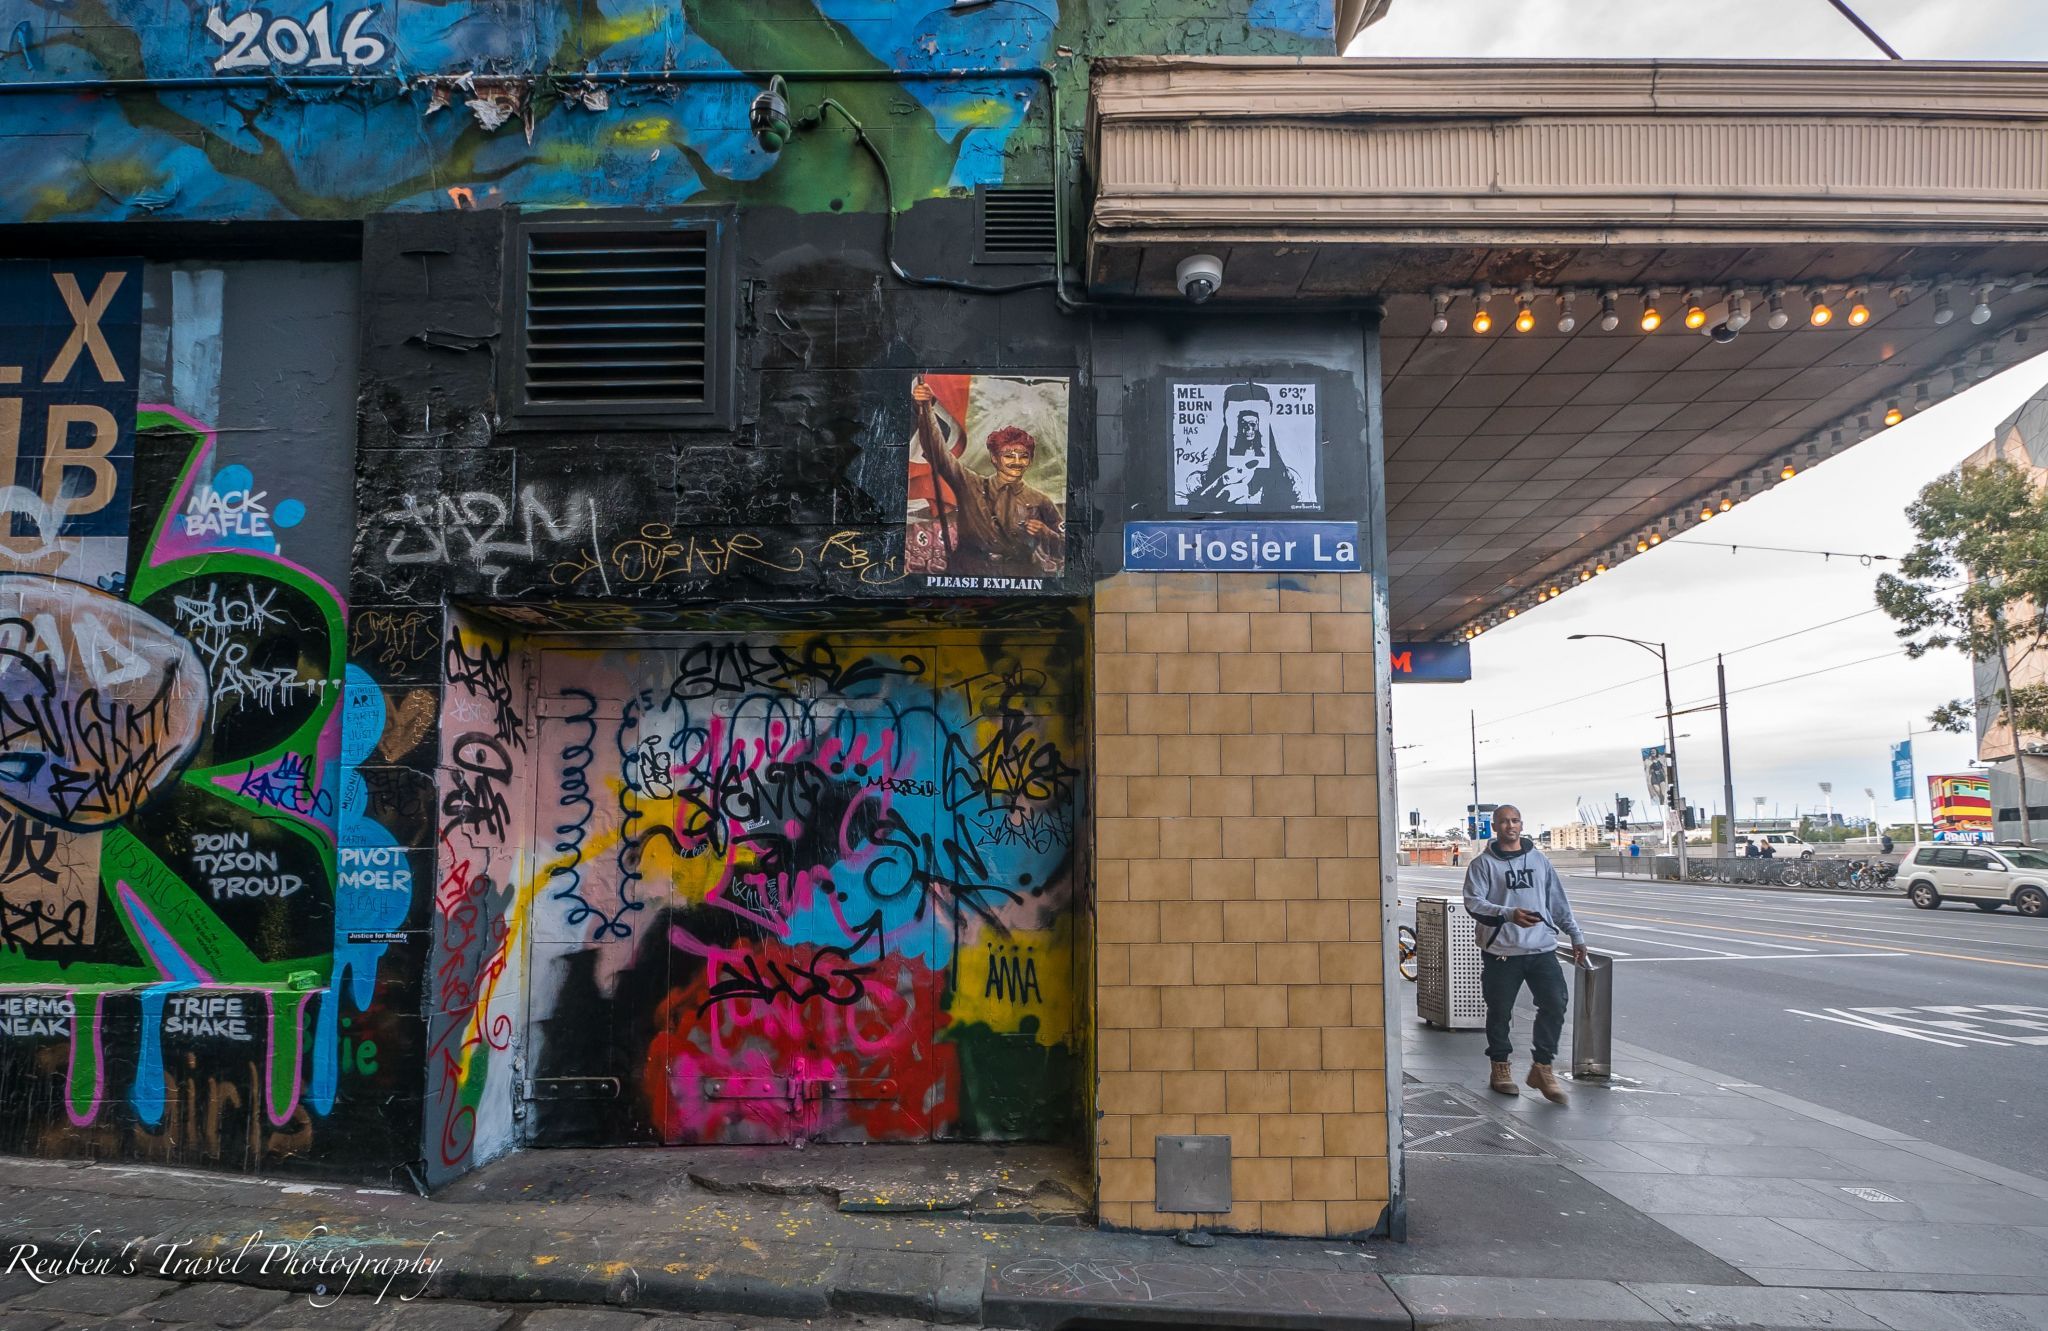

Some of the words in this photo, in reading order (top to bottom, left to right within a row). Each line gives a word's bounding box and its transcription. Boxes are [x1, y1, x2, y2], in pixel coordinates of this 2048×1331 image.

[205, 5, 386, 71] 2016
[1177, 387, 1204, 399] MEL
[1178, 401, 1213, 412] BURN
[1178, 413, 1206, 425] BUG
[1183, 426, 1198, 435] HAS
[1185, 436, 1192, 446] A
[185, 512, 274, 538] BAFLE
[1178, 533, 1297, 562] Hosier
[1313, 533, 1355, 562] La
[926, 575, 980, 589] PLEASE
[982, 577, 1043, 591] EXPLAIN
[353, 695, 379, 708] ART
[192, 852, 278, 874] TYSON
[340, 846, 409, 867] PIVOT
[209, 876, 302, 899] PROUD
[338, 869, 412, 893] MOER
[1504, 868, 1536, 890] CAT
[385, 932, 408, 940] Maddy
[169, 998, 245, 1019] TRIFE
[165, 1016, 252, 1041] SHAKE
